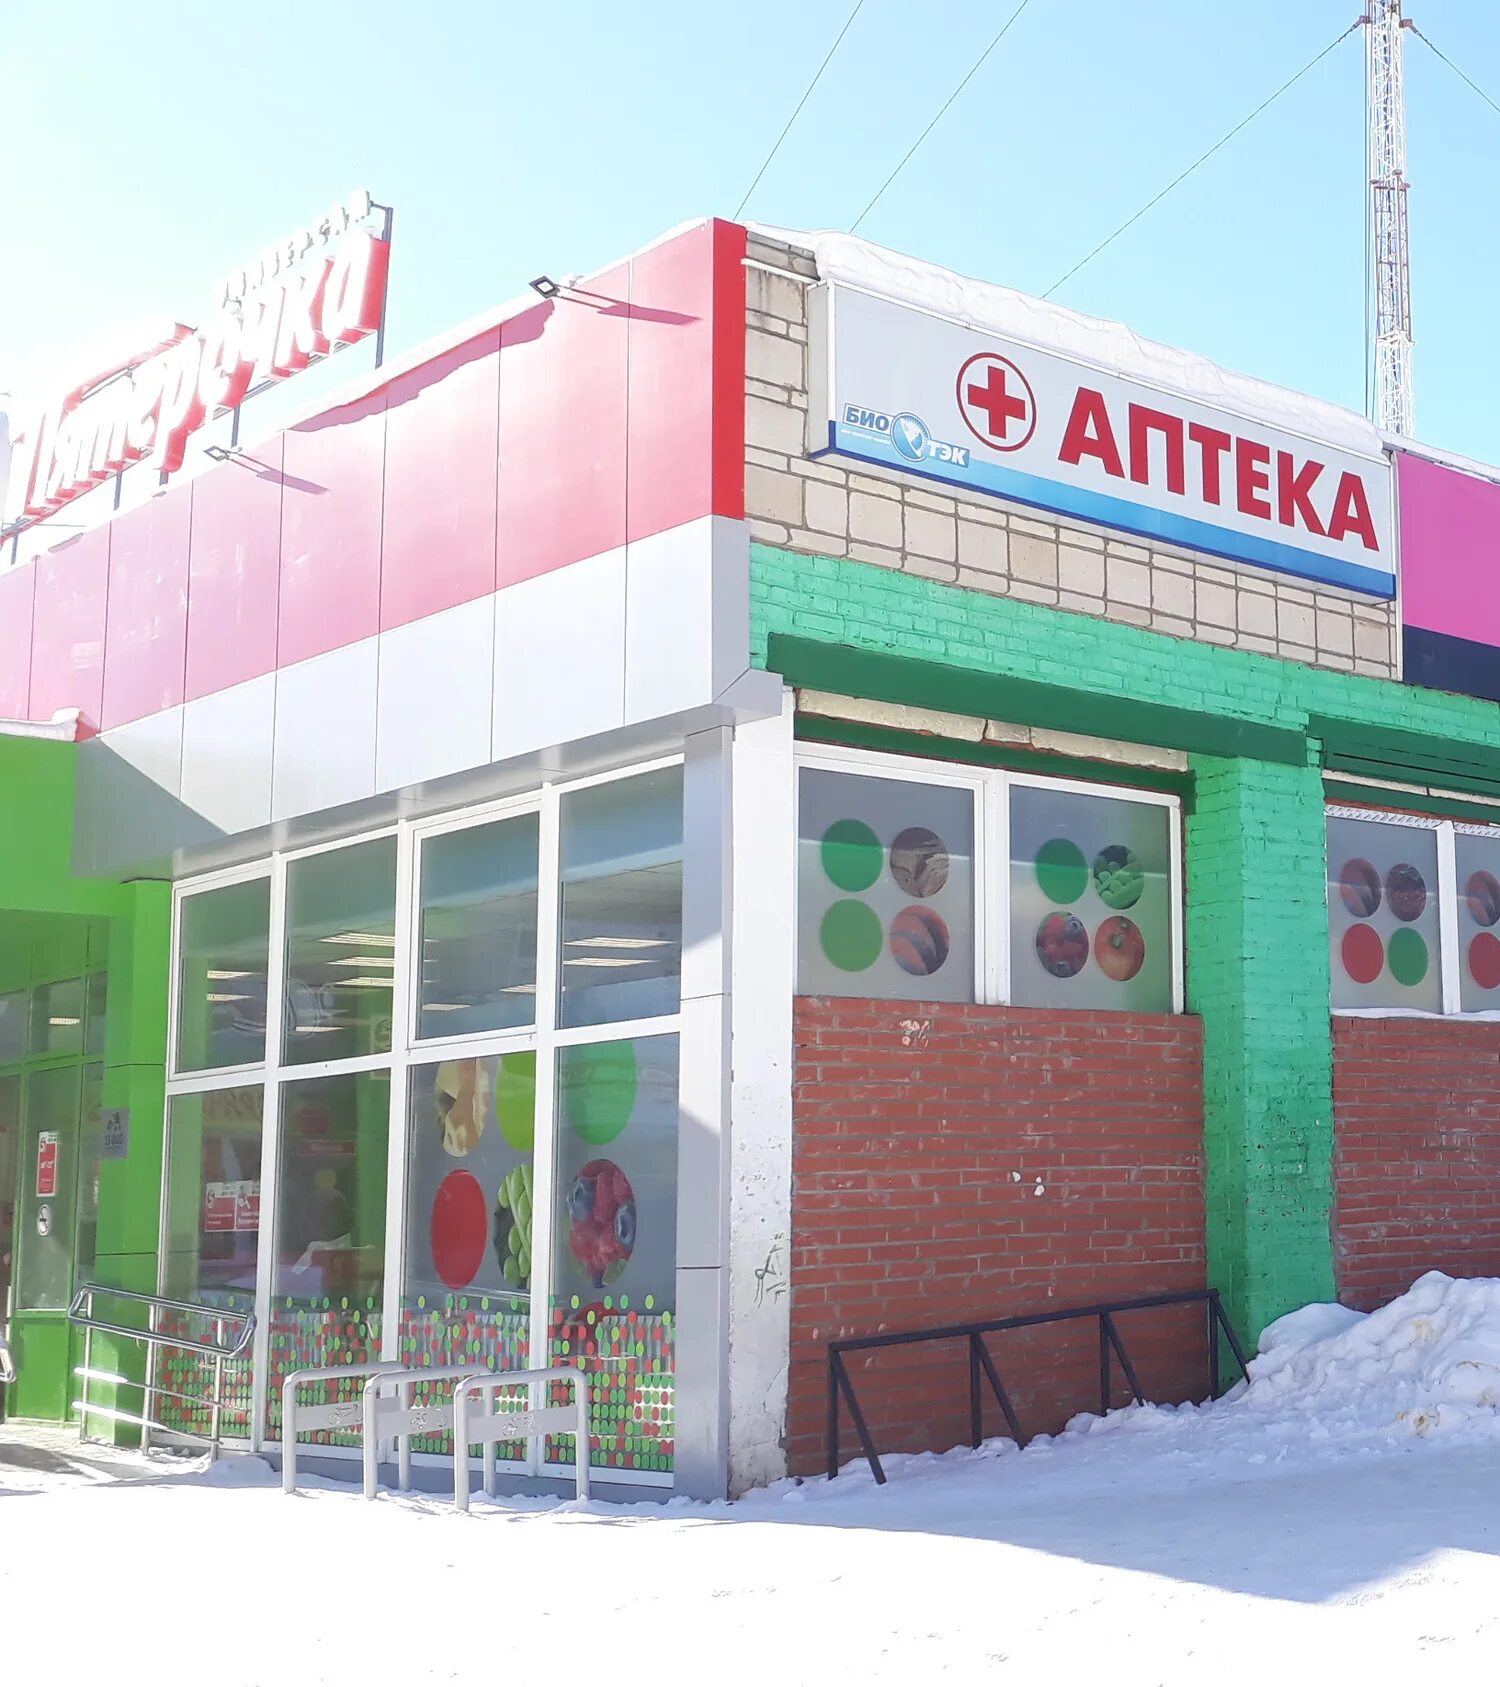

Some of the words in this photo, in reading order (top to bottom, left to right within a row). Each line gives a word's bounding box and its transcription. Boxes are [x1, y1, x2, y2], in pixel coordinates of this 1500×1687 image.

[846, 407, 889, 431] БИО
[927, 441, 967, 465] ТЭК
[1058, 386, 1380, 552] АПТЕКА
